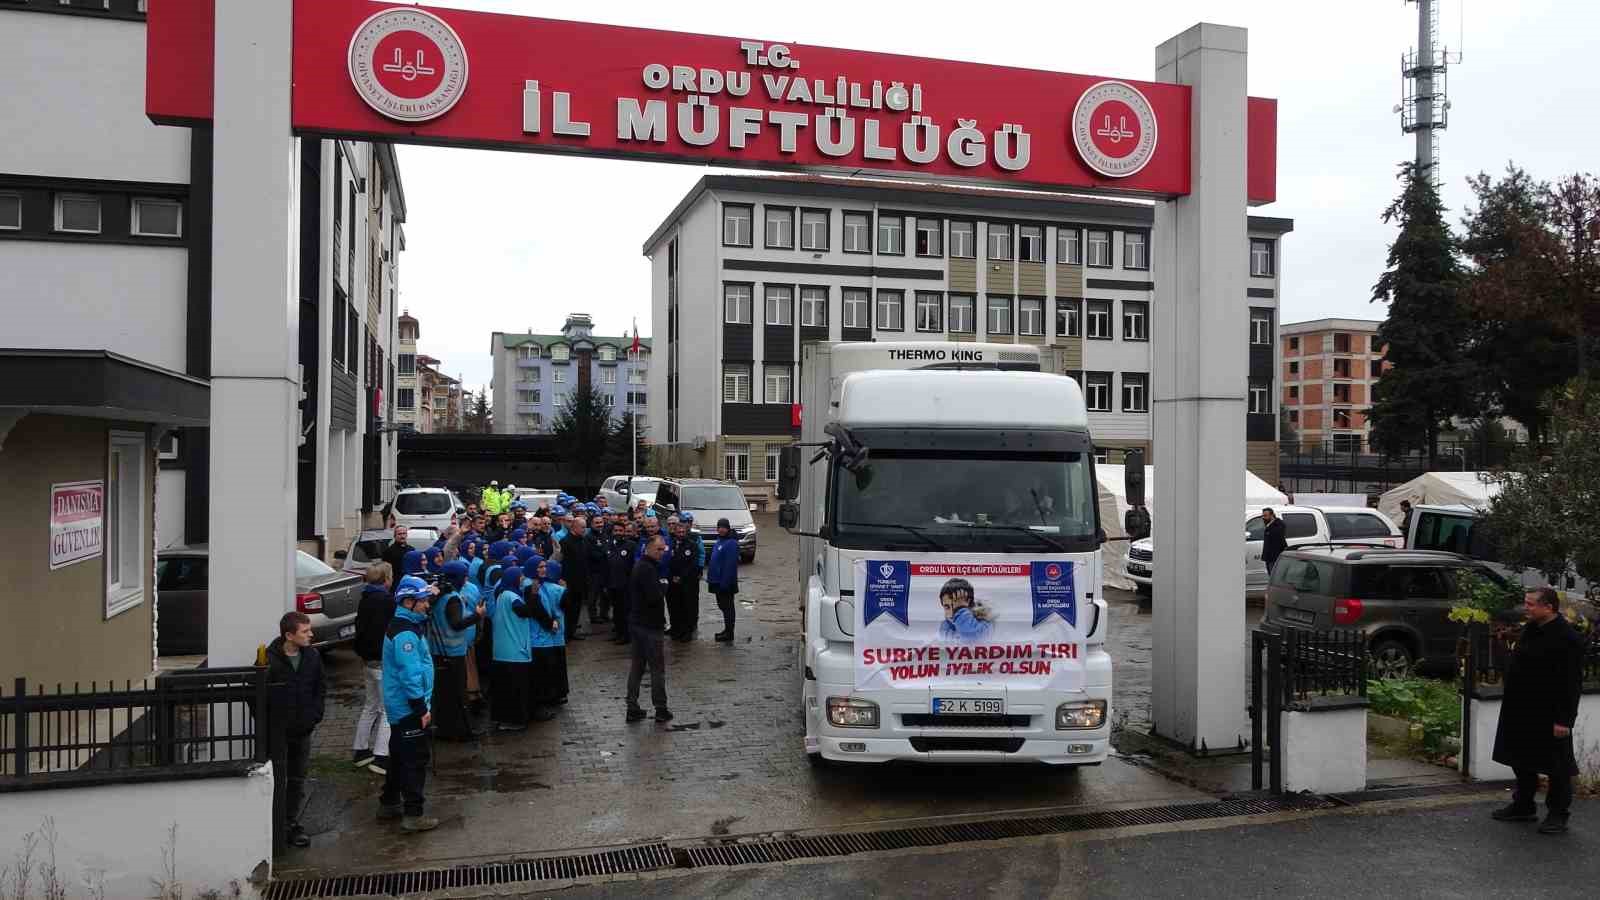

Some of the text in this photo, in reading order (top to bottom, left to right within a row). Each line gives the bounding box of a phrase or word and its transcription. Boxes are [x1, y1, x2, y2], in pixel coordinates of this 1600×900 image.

[741, 40, 799, 69] T.C.
[642, 63, 922, 113] ORDU VALİLİĞİ
[522, 79, 1032, 172] İL MÜFTÜLÜĞÜ
[888, 349, 983, 361] THERMO KING
[919, 566, 939, 574] ORDU
[947, 566, 956, 574] VE
[863, 643, 1078, 665] SURİYE YARDIM TIRI
[890, 663, 939, 681] YOLUN
[1000, 661, 1051, 676] OLSUN
[940, 700, 1000, 713] 52 K 5199
